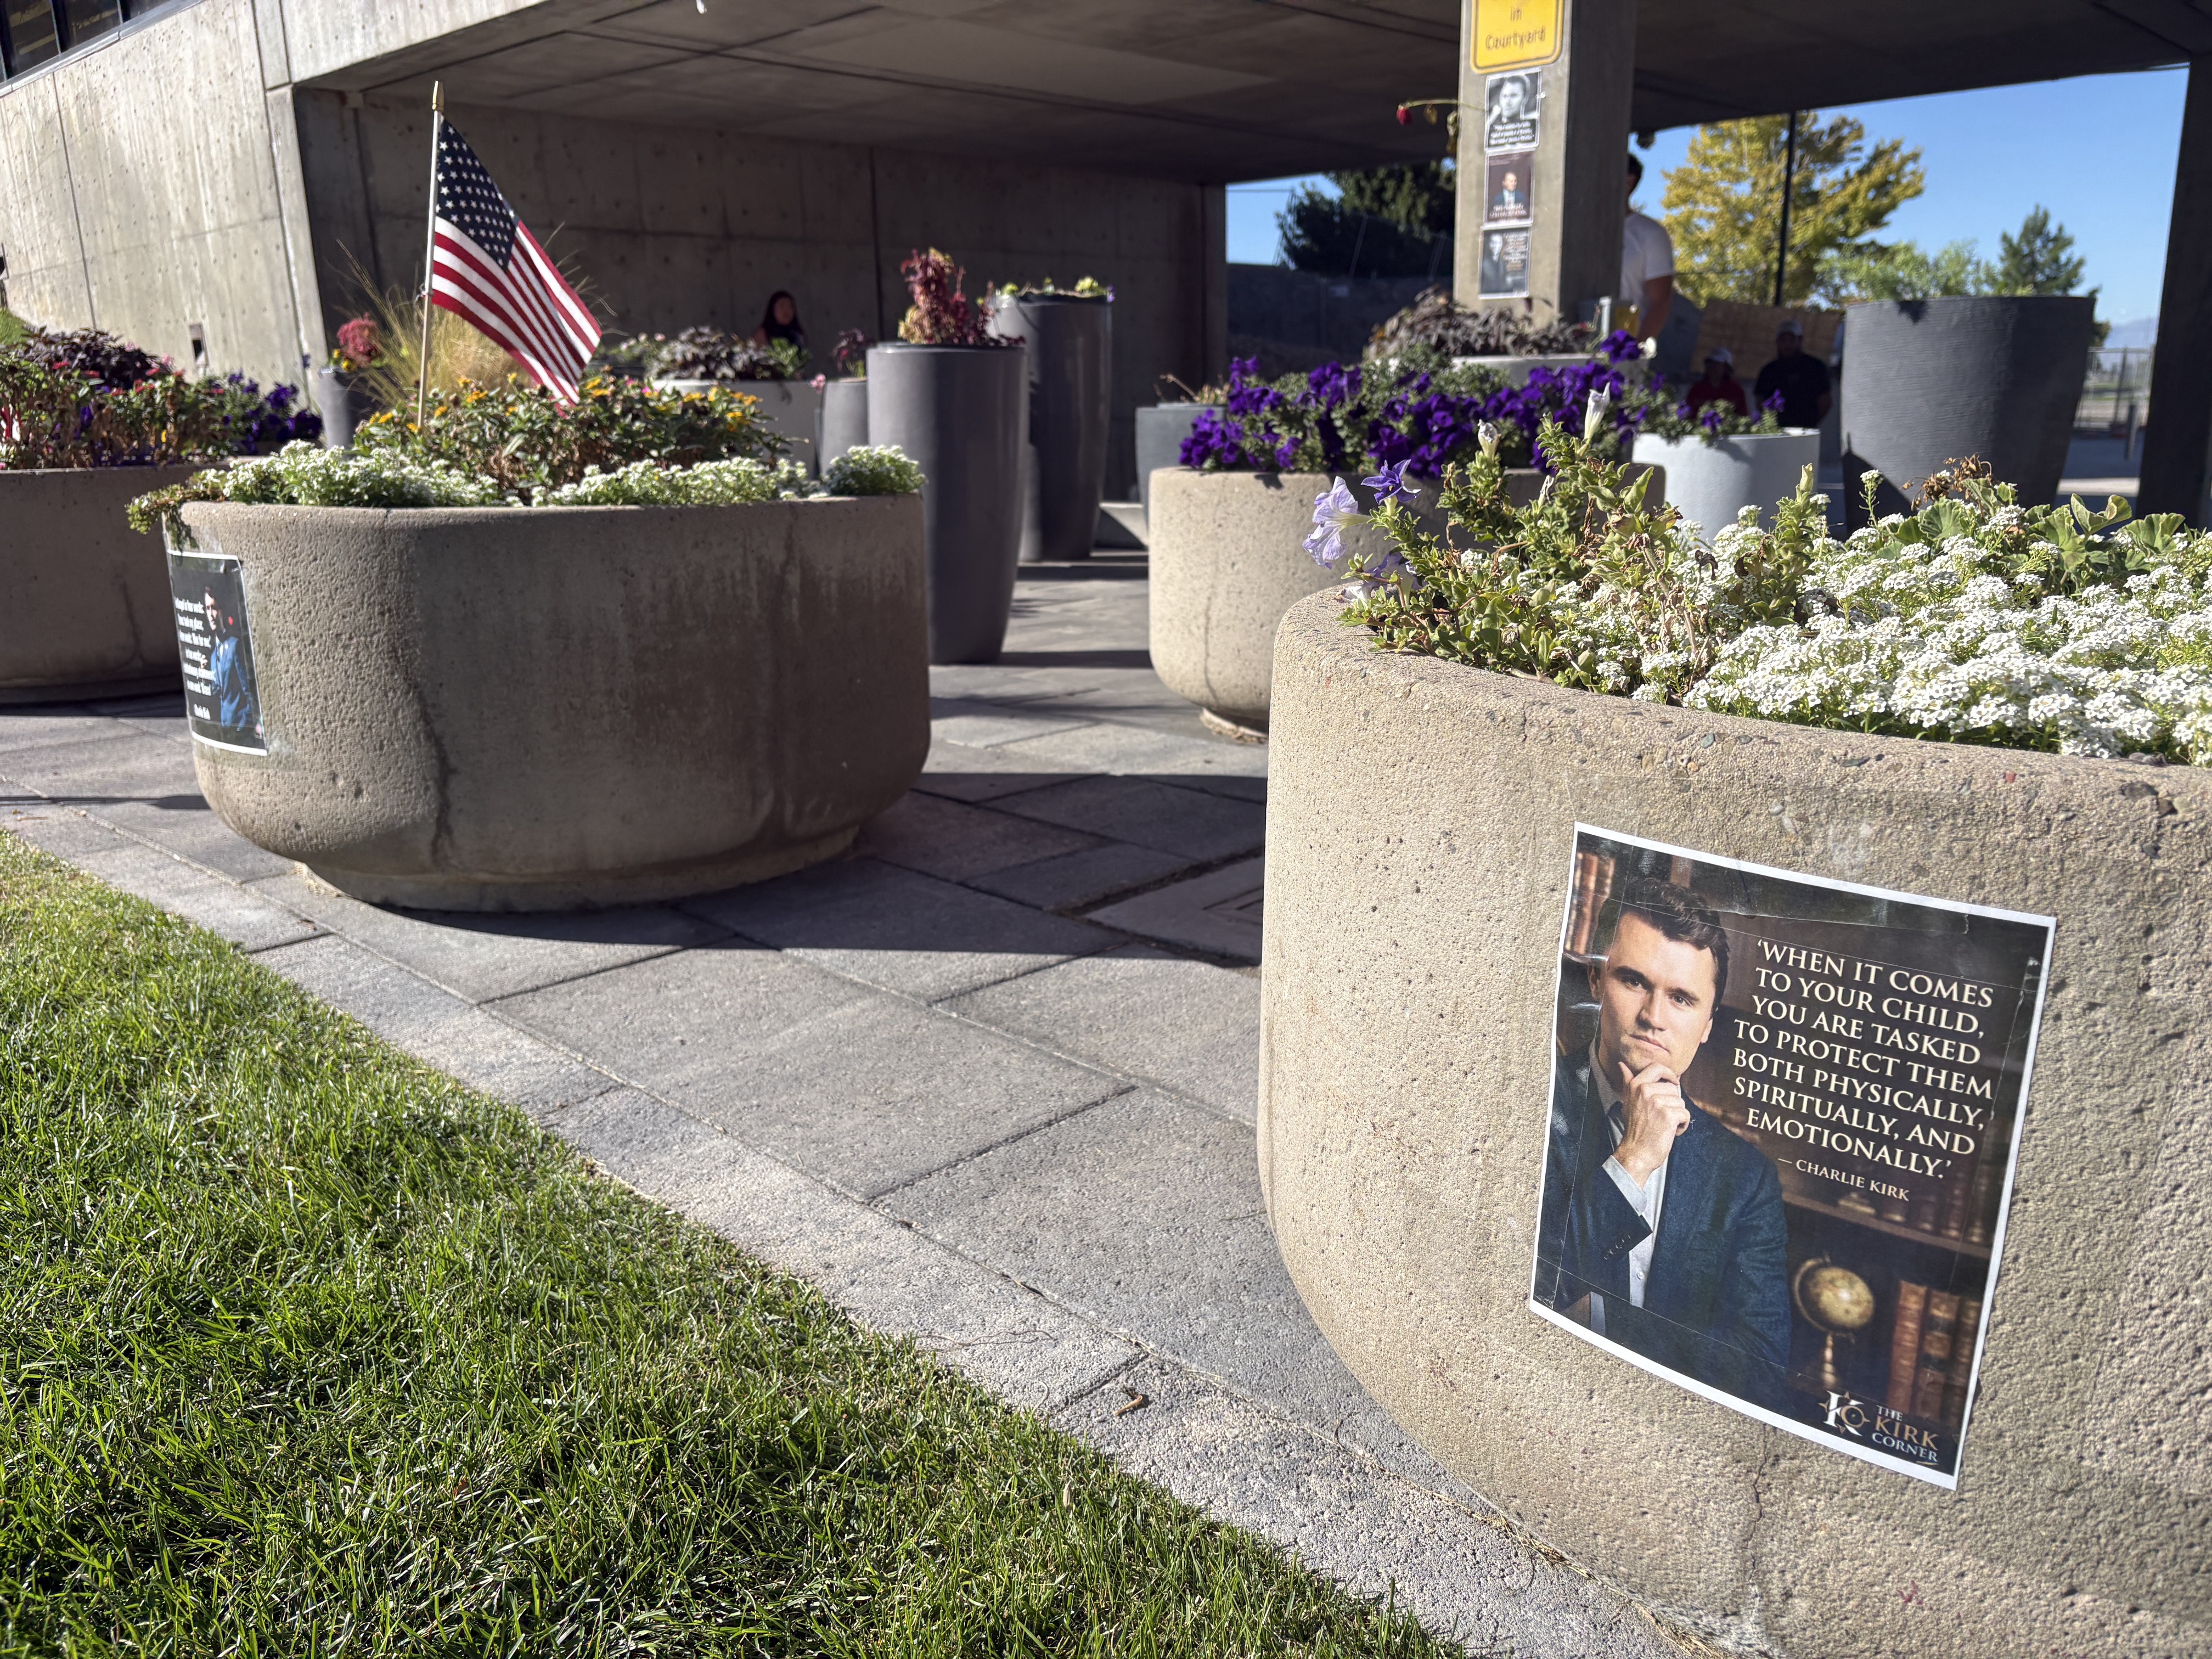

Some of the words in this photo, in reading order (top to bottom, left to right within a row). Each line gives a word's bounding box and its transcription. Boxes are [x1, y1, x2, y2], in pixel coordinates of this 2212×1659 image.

[1485, 25, 1546, 50] Courtyard
[1510, 5, 1522, 21] in
[1757, 939, 1846, 977] ‘WHEN
[1854, 962, 1883, 984] IT
[1889, 970, 1994, 1008] COMES
[1752, 995, 1807, 1025] YOU
[1810, 1011, 1864, 1039] ARE
[1871, 1023, 1981, 1064] TASKED
[1755, 967, 1791, 992] TO
[1798, 977, 1876, 1013] YOUR
[1882, 998, 1984, 1039] CHILD,
[1733, 1019, 1769, 1044] TO
[1775, 1030, 1900, 1077] PROTECT
[1906, 1062, 1993, 1099] THEM
[1733, 1048, 1805, 1084] BOTH
[1812, 1069, 1984, 1131] PHYSICALLY,
[1733, 1077, 1899, 1140] SPIRITUALLY,
[1905, 1124, 1975, 1154] AND
[1796, 1159, 1865, 1188] CHARLIE
[1869, 1180, 1910, 1201] KIRK
[1875, 1415, 1939, 1451] KIRK
[1876, 1405, 1903, 1421] THE
[1871, 1432, 1938, 1463] CORNER
